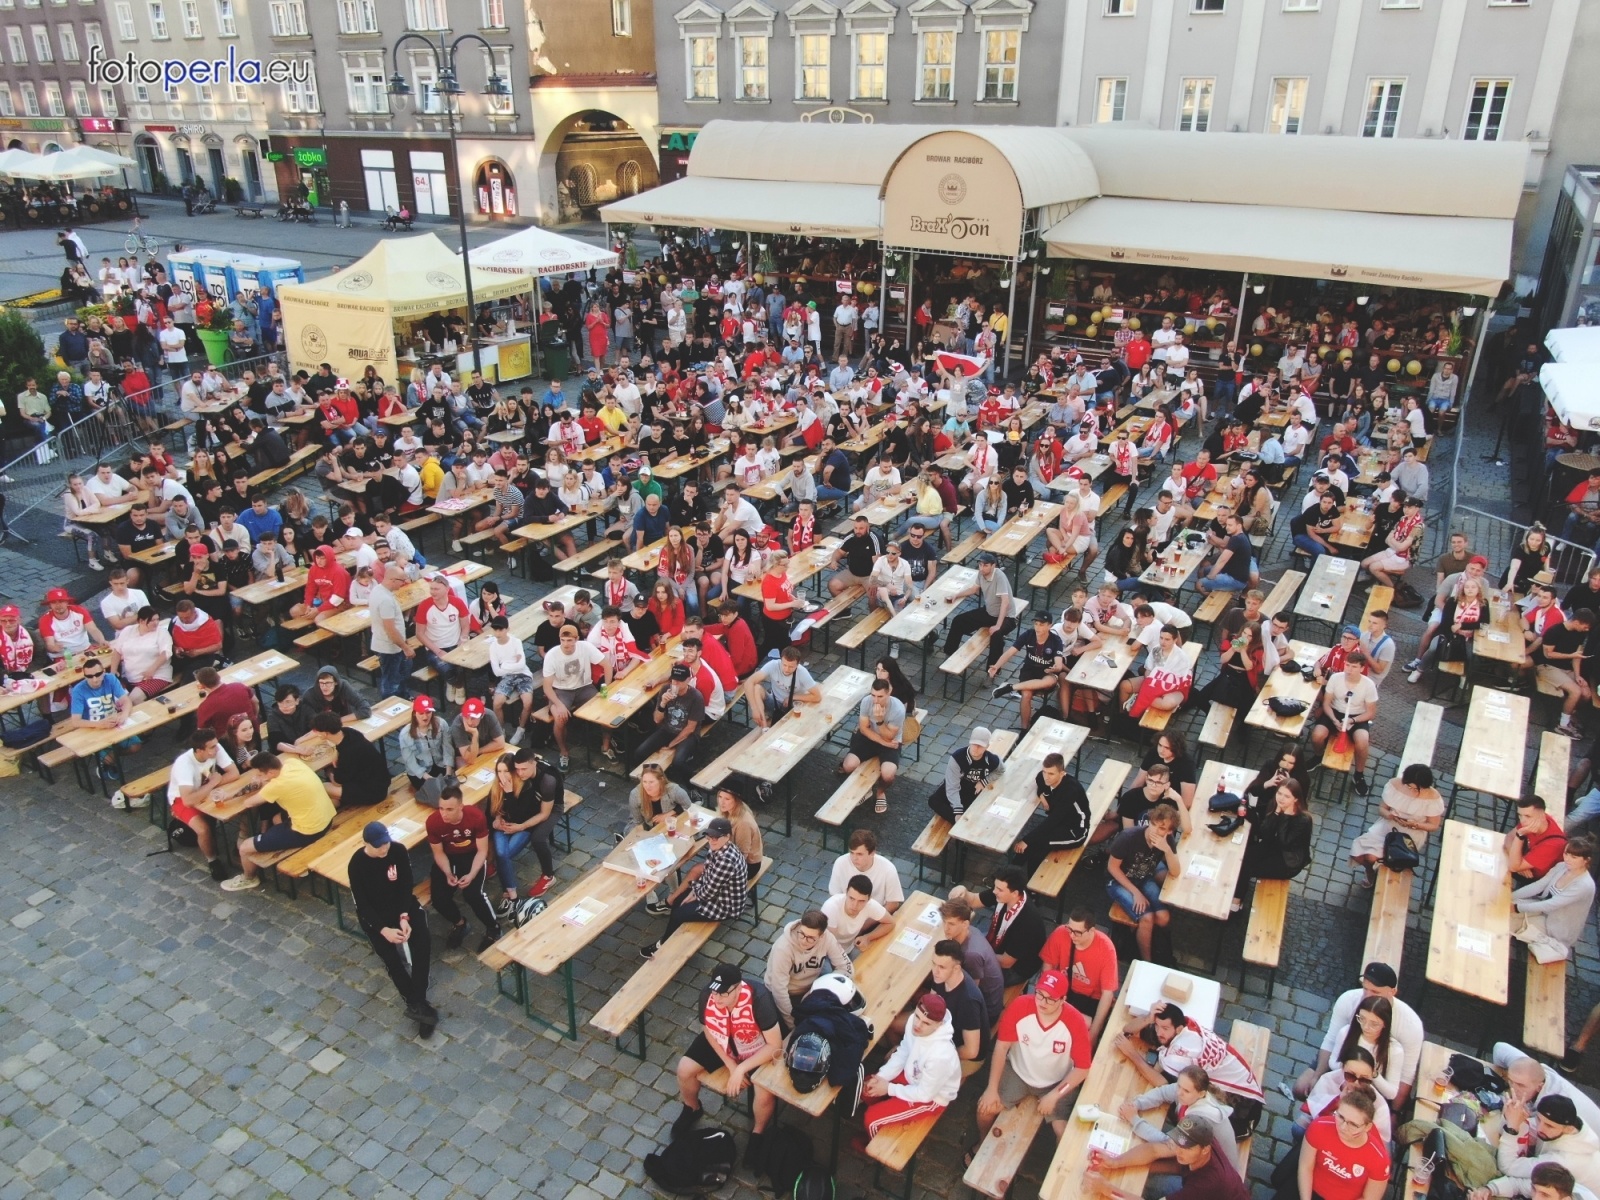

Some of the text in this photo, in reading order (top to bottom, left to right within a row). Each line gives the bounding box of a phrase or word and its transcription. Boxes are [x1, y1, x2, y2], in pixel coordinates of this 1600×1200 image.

[298, 151, 322, 162] żabka
[926, 155, 984, 165] BROWAR RACIBÓRZ
[538, 261, 588, 275] RACIBORSKIE
[1323, 1157, 1352, 1179] Polska
